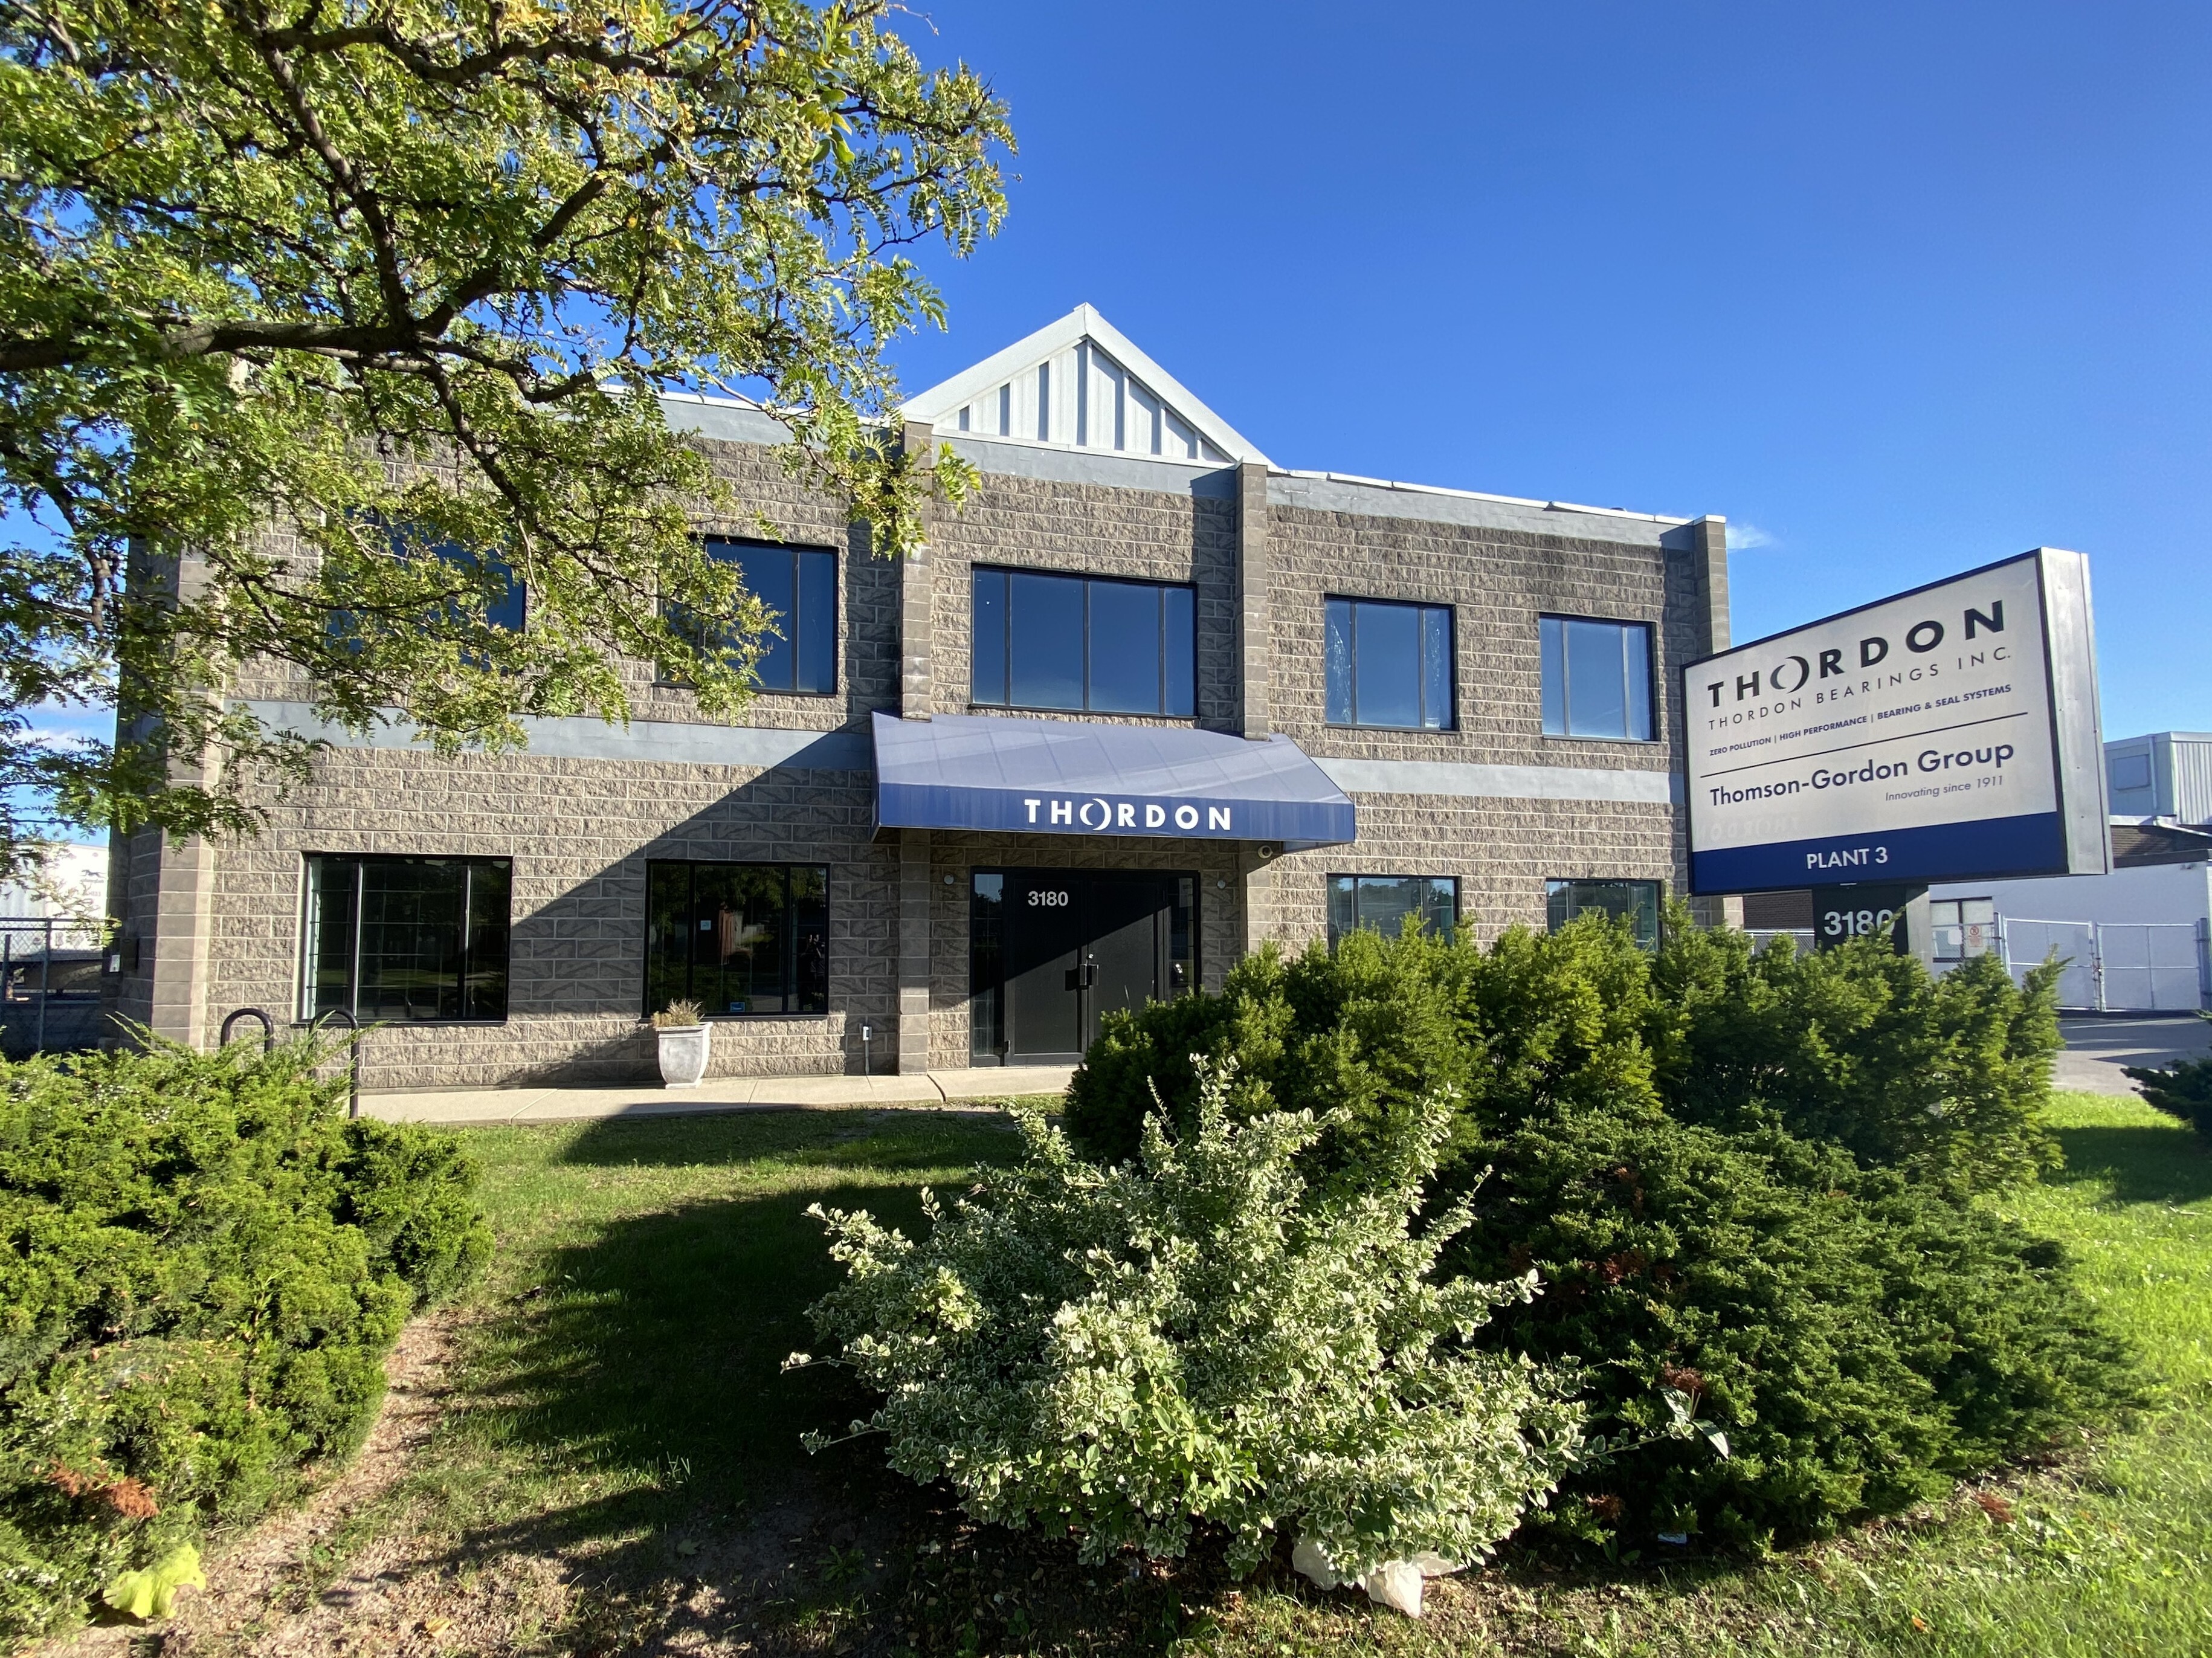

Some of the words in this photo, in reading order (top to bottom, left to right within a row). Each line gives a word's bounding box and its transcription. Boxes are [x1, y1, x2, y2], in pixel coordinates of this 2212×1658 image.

[1707, 599, 2005, 709] THORDON
[1708, 697, 1801, 731] THORDON
[1816, 663, 1939, 705] BEARINGS
[1957, 647, 2011, 671] INC.
[1709, 746, 1728, 756] ZERO
[1729, 736, 1772, 752] POLLUTION
[1779, 729, 1801, 741] HIGH
[1803, 715, 1868, 736] PERFORMANCE
[1877, 704, 1921, 720] BEARING
[1924, 702, 1932, 710] &
[1935, 695, 1961, 708] SEAL
[1963, 683, 2011, 702] SYSTEMS
[1709, 758, 1909, 807] Thomson-Gordon
[1917, 744, 2014, 773] Group
[1885, 787, 1940, 801] Innovating
[1943, 783, 1972, 793] since
[1977, 775, 2004, 789] 1911
[1024, 798, 1231, 831] THORDON
[1805, 848, 1870, 870] PLANT
[1875, 847, 1889, 865] 3
[1027, 891, 1069, 906] 3180
[1823, 909, 1895, 936] 3180
